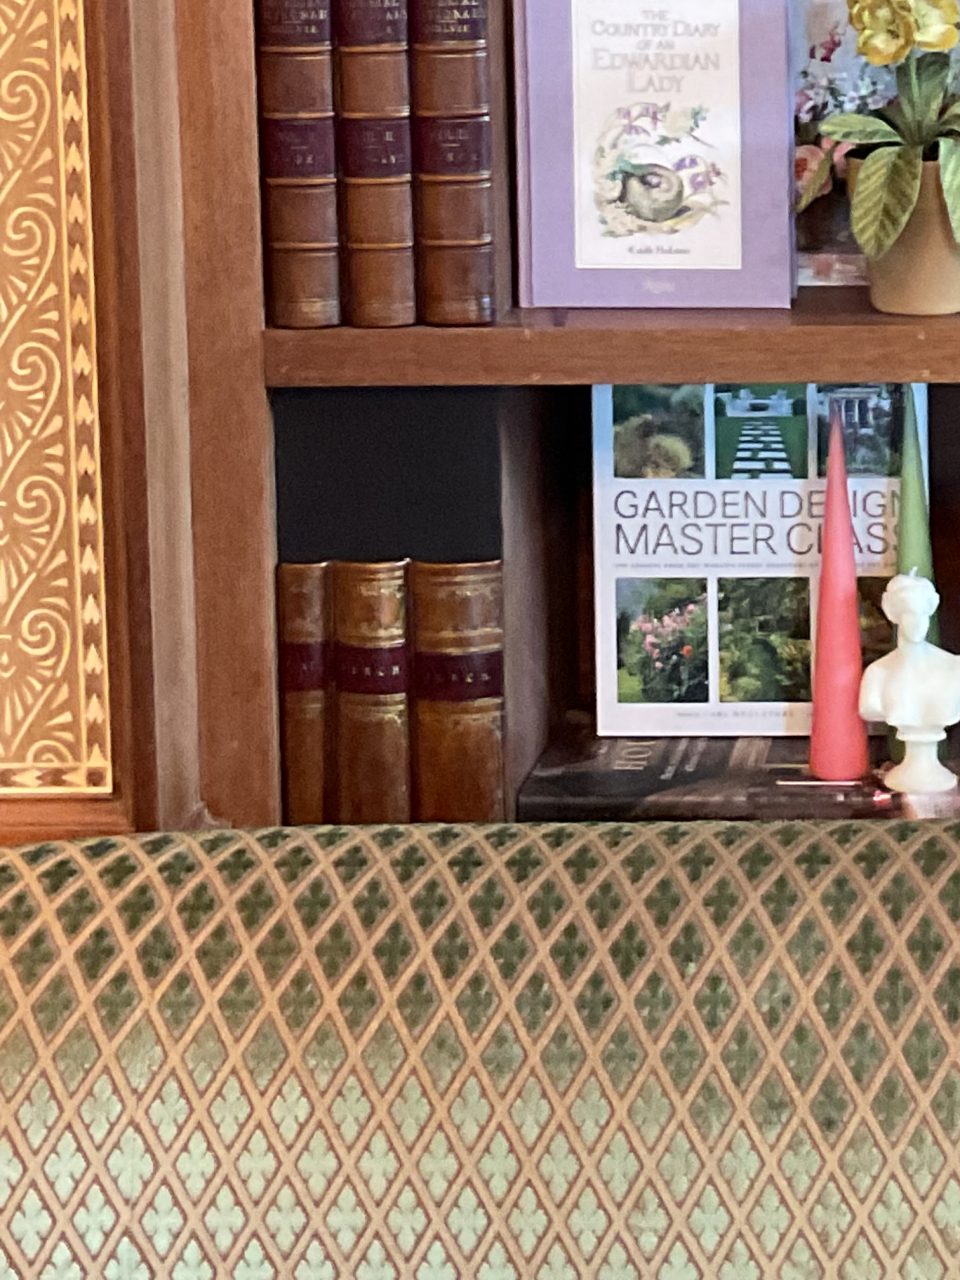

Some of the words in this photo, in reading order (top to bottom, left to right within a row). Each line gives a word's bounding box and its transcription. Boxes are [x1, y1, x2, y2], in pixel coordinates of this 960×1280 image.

[641, 10, 670, 21] THE
[591, 19, 669, 37] COUNTRY
[673, 20, 720, 37] DIARY
[591, 48, 720, 71] EDWARDIAN
[625, 67, 685, 93] LADY
[613, 490, 767, 519] GARDEN
[779, 489, 902, 519] DEIG
[615, 523, 778, 555] MASTER
